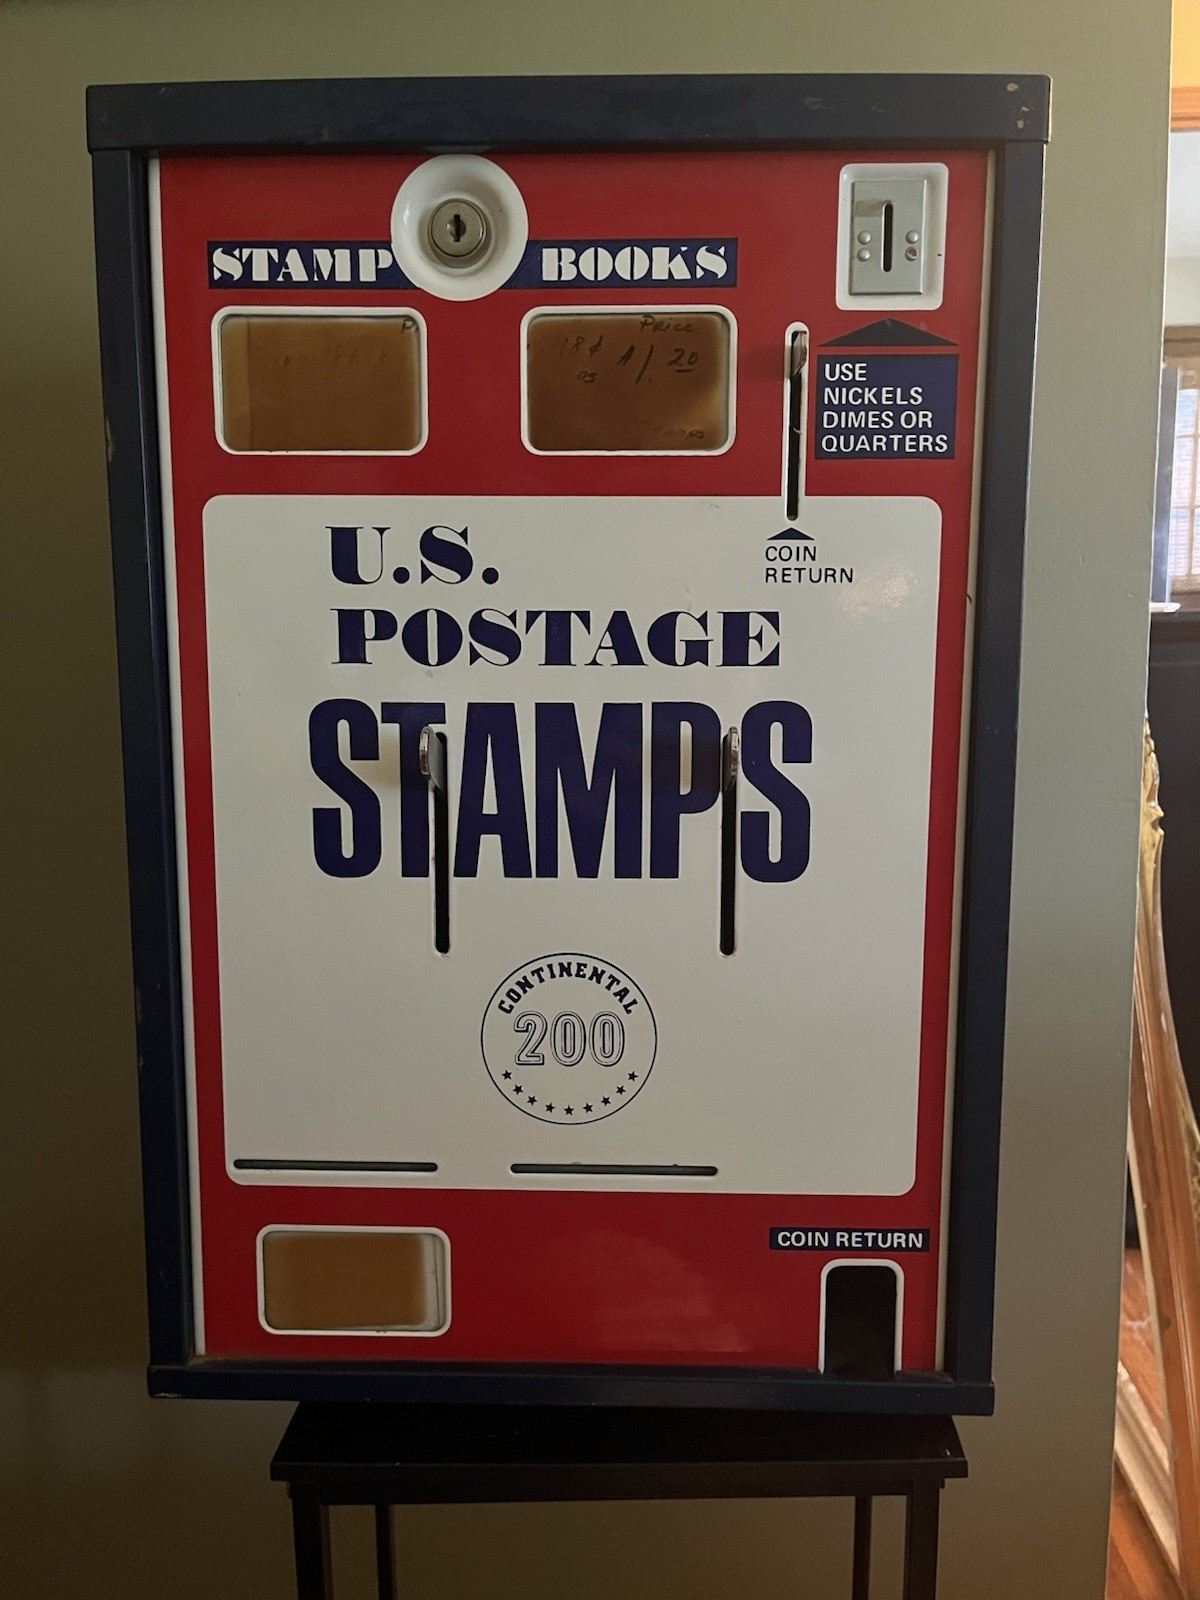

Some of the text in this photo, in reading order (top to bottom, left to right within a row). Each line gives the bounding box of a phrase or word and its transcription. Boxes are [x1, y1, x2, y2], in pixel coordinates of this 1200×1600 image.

[211, 244, 728, 282] STAMP BOOKS
[824, 362, 868, 382] USE
[823, 386, 923, 406] NICKELS
[822, 410, 933, 430] DIMES OR
[821, 434, 949, 454] QUARTERS
[325, 525, 499, 585] U.S.
[765, 545, 817, 563] COIN
[765, 566, 854, 584] RETURN
[330, 608, 780, 667] POSTAGE
[308, 698, 813, 883] STAMPS
[497, 961, 638, 1015] CONTINENTAL
[513, 1010, 625, 1067] 200
[777, 1231, 923, 1249] COIN RETURN
